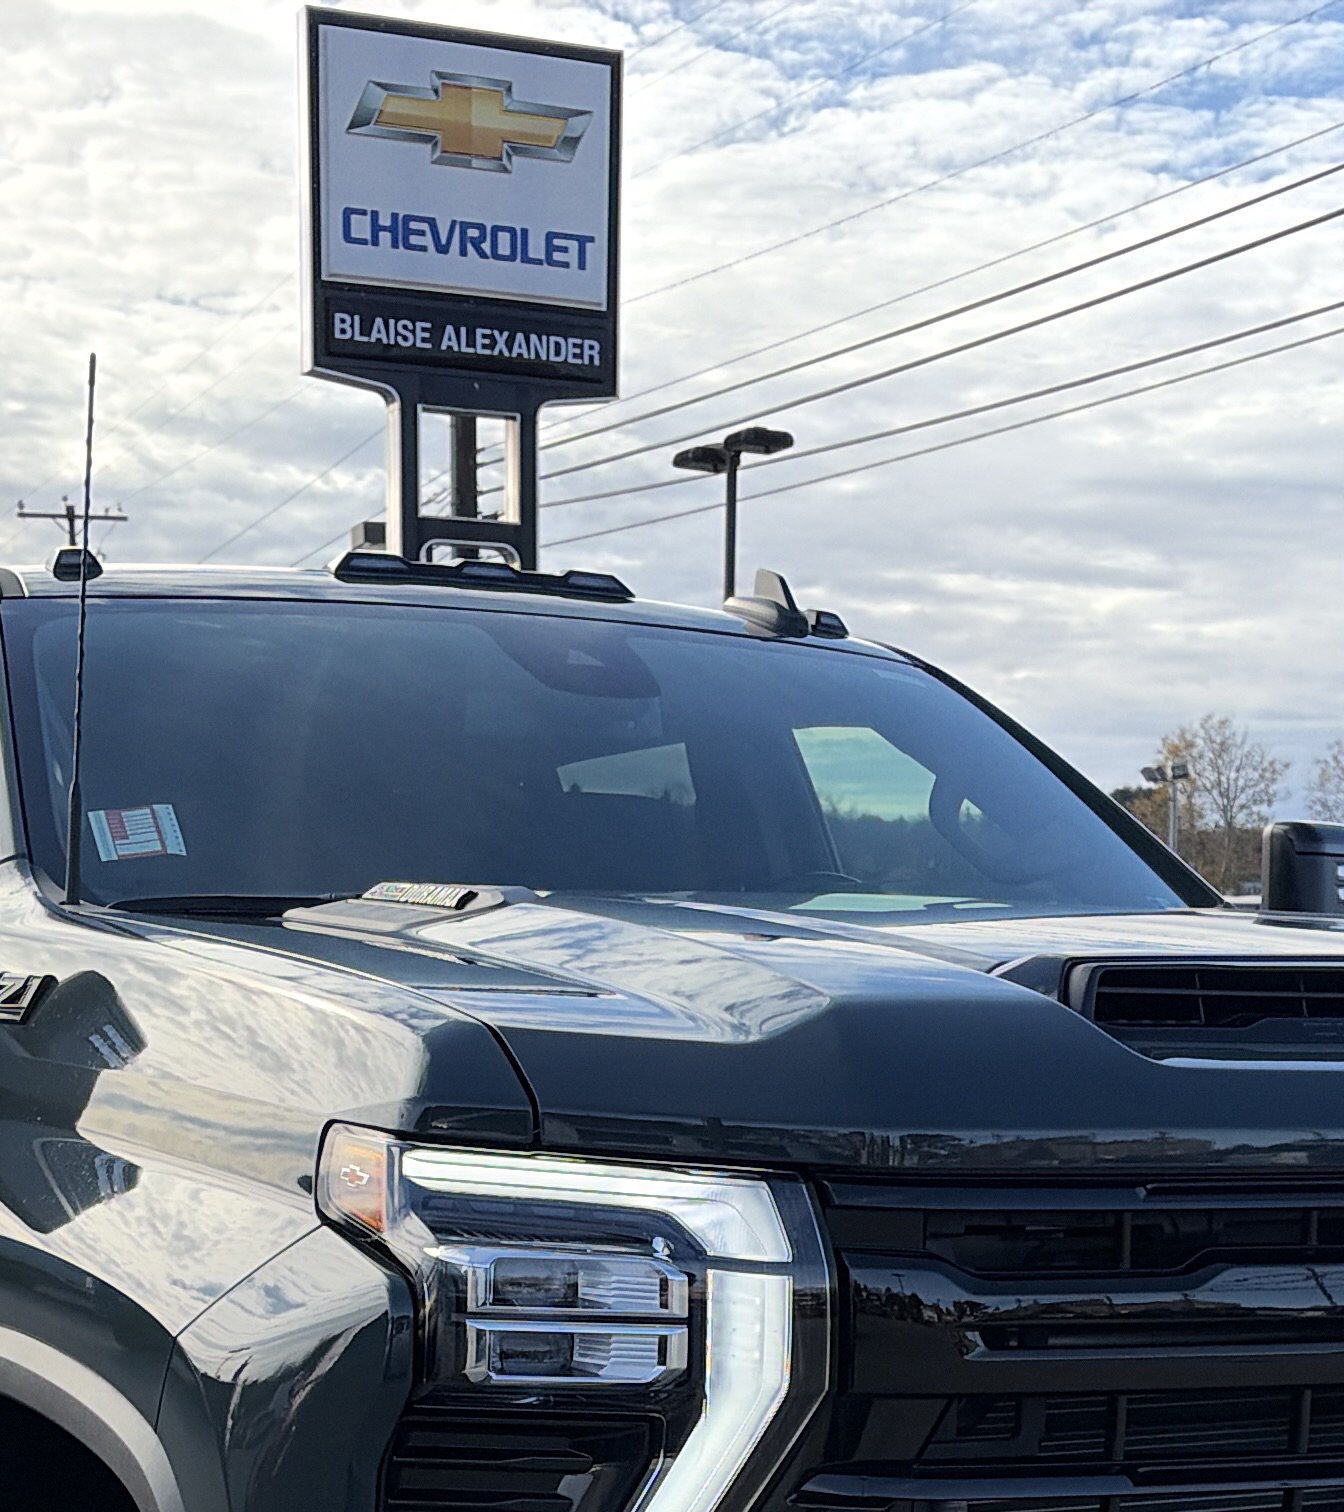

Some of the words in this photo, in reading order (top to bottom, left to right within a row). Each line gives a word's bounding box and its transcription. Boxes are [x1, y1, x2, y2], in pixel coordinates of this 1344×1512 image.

[342, 206, 595, 271] CHEVROLET
[333, 312, 432, 350] BLAISE
[440, 324, 601, 367] ALEXANDER
